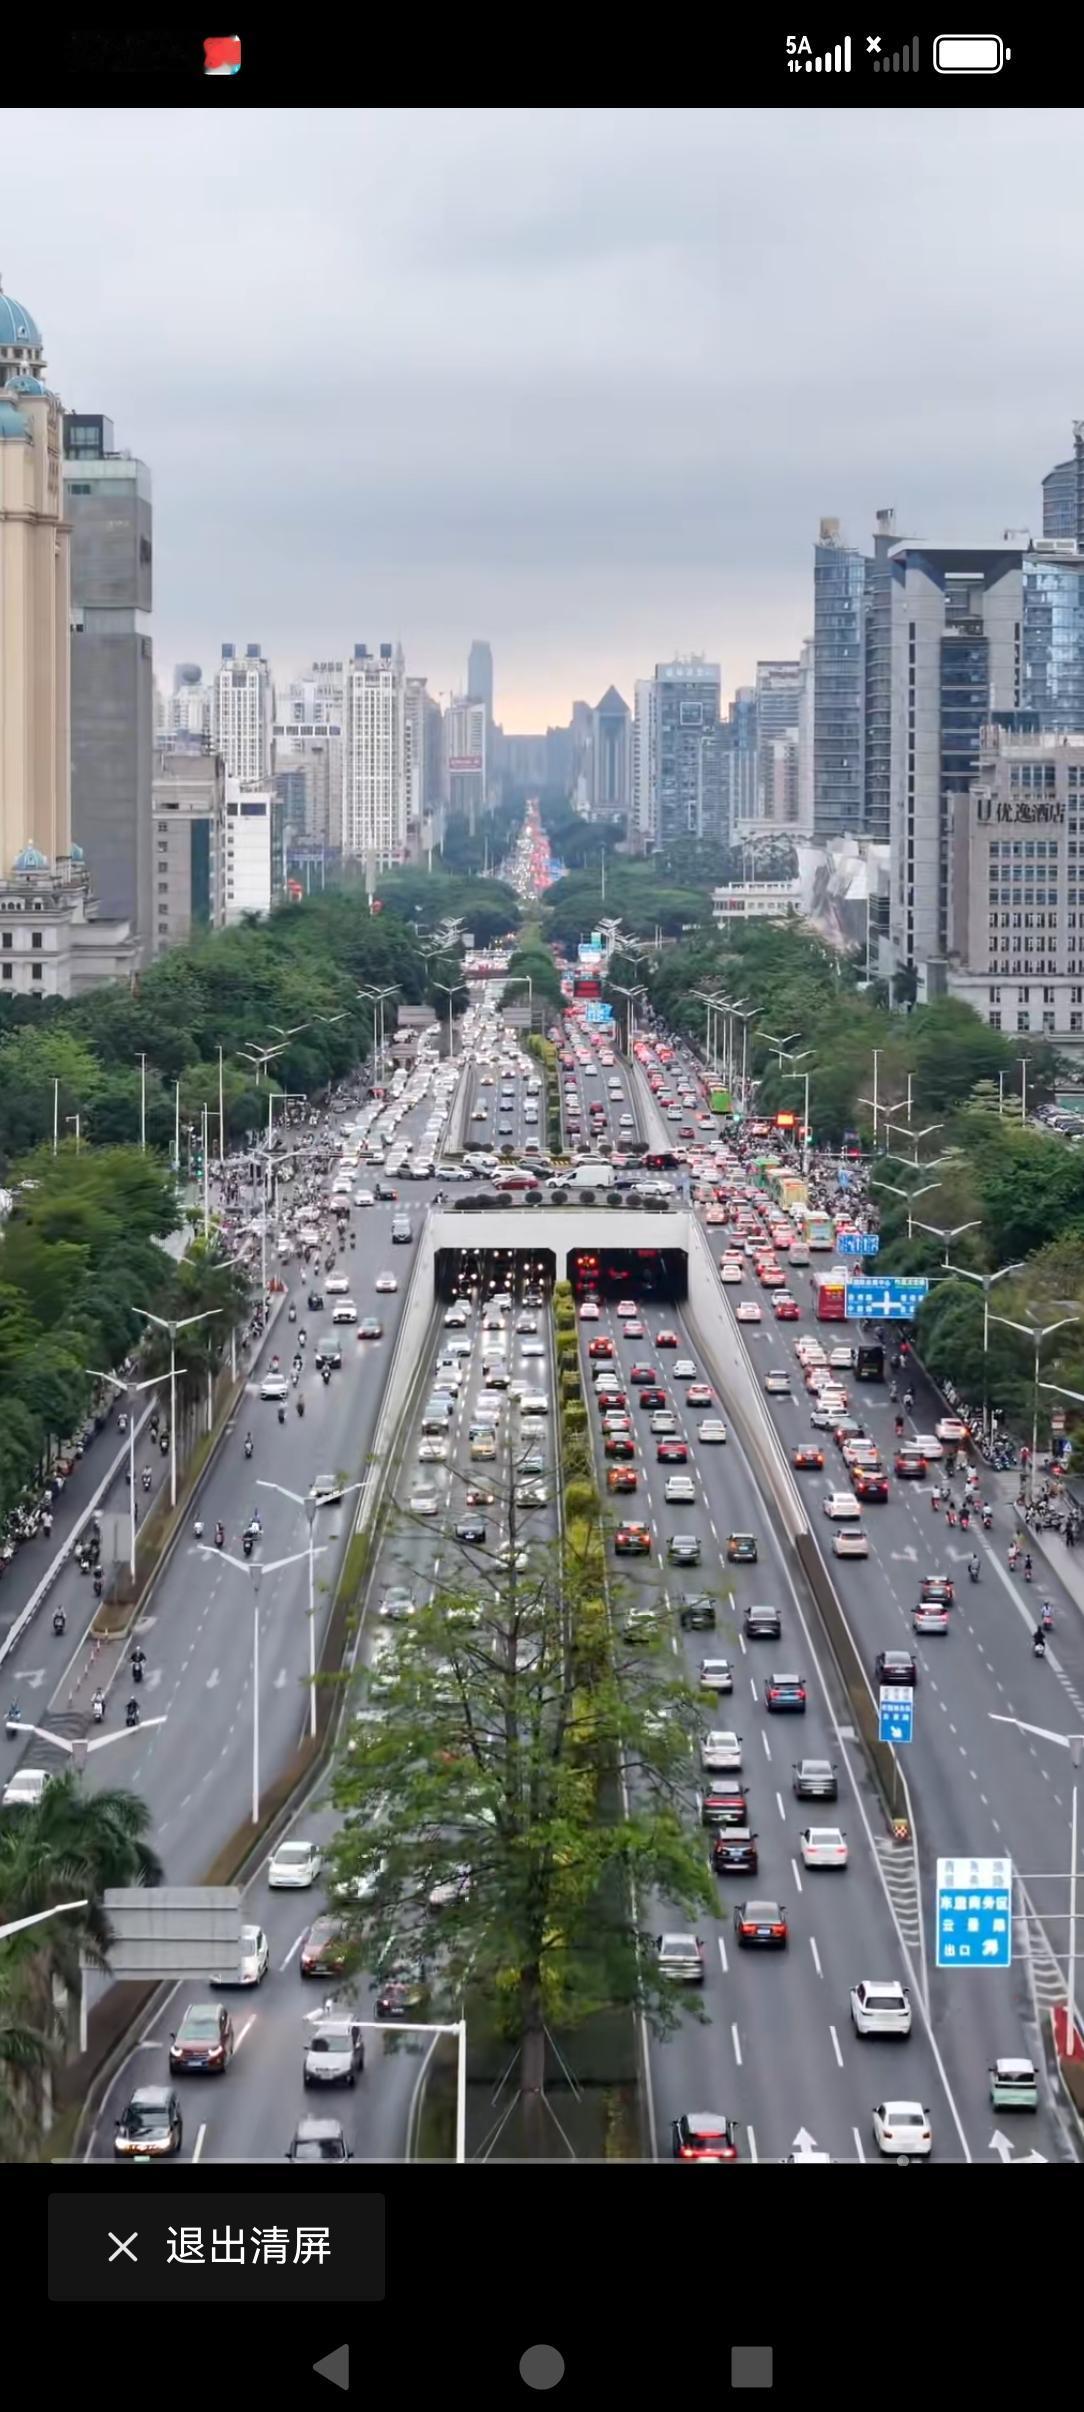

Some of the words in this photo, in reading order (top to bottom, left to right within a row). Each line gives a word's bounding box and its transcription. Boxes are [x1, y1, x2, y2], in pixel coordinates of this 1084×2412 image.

[996, 801, 1067, 824] 优逸酒店
[944, 1943, 971, 1957] 出口
